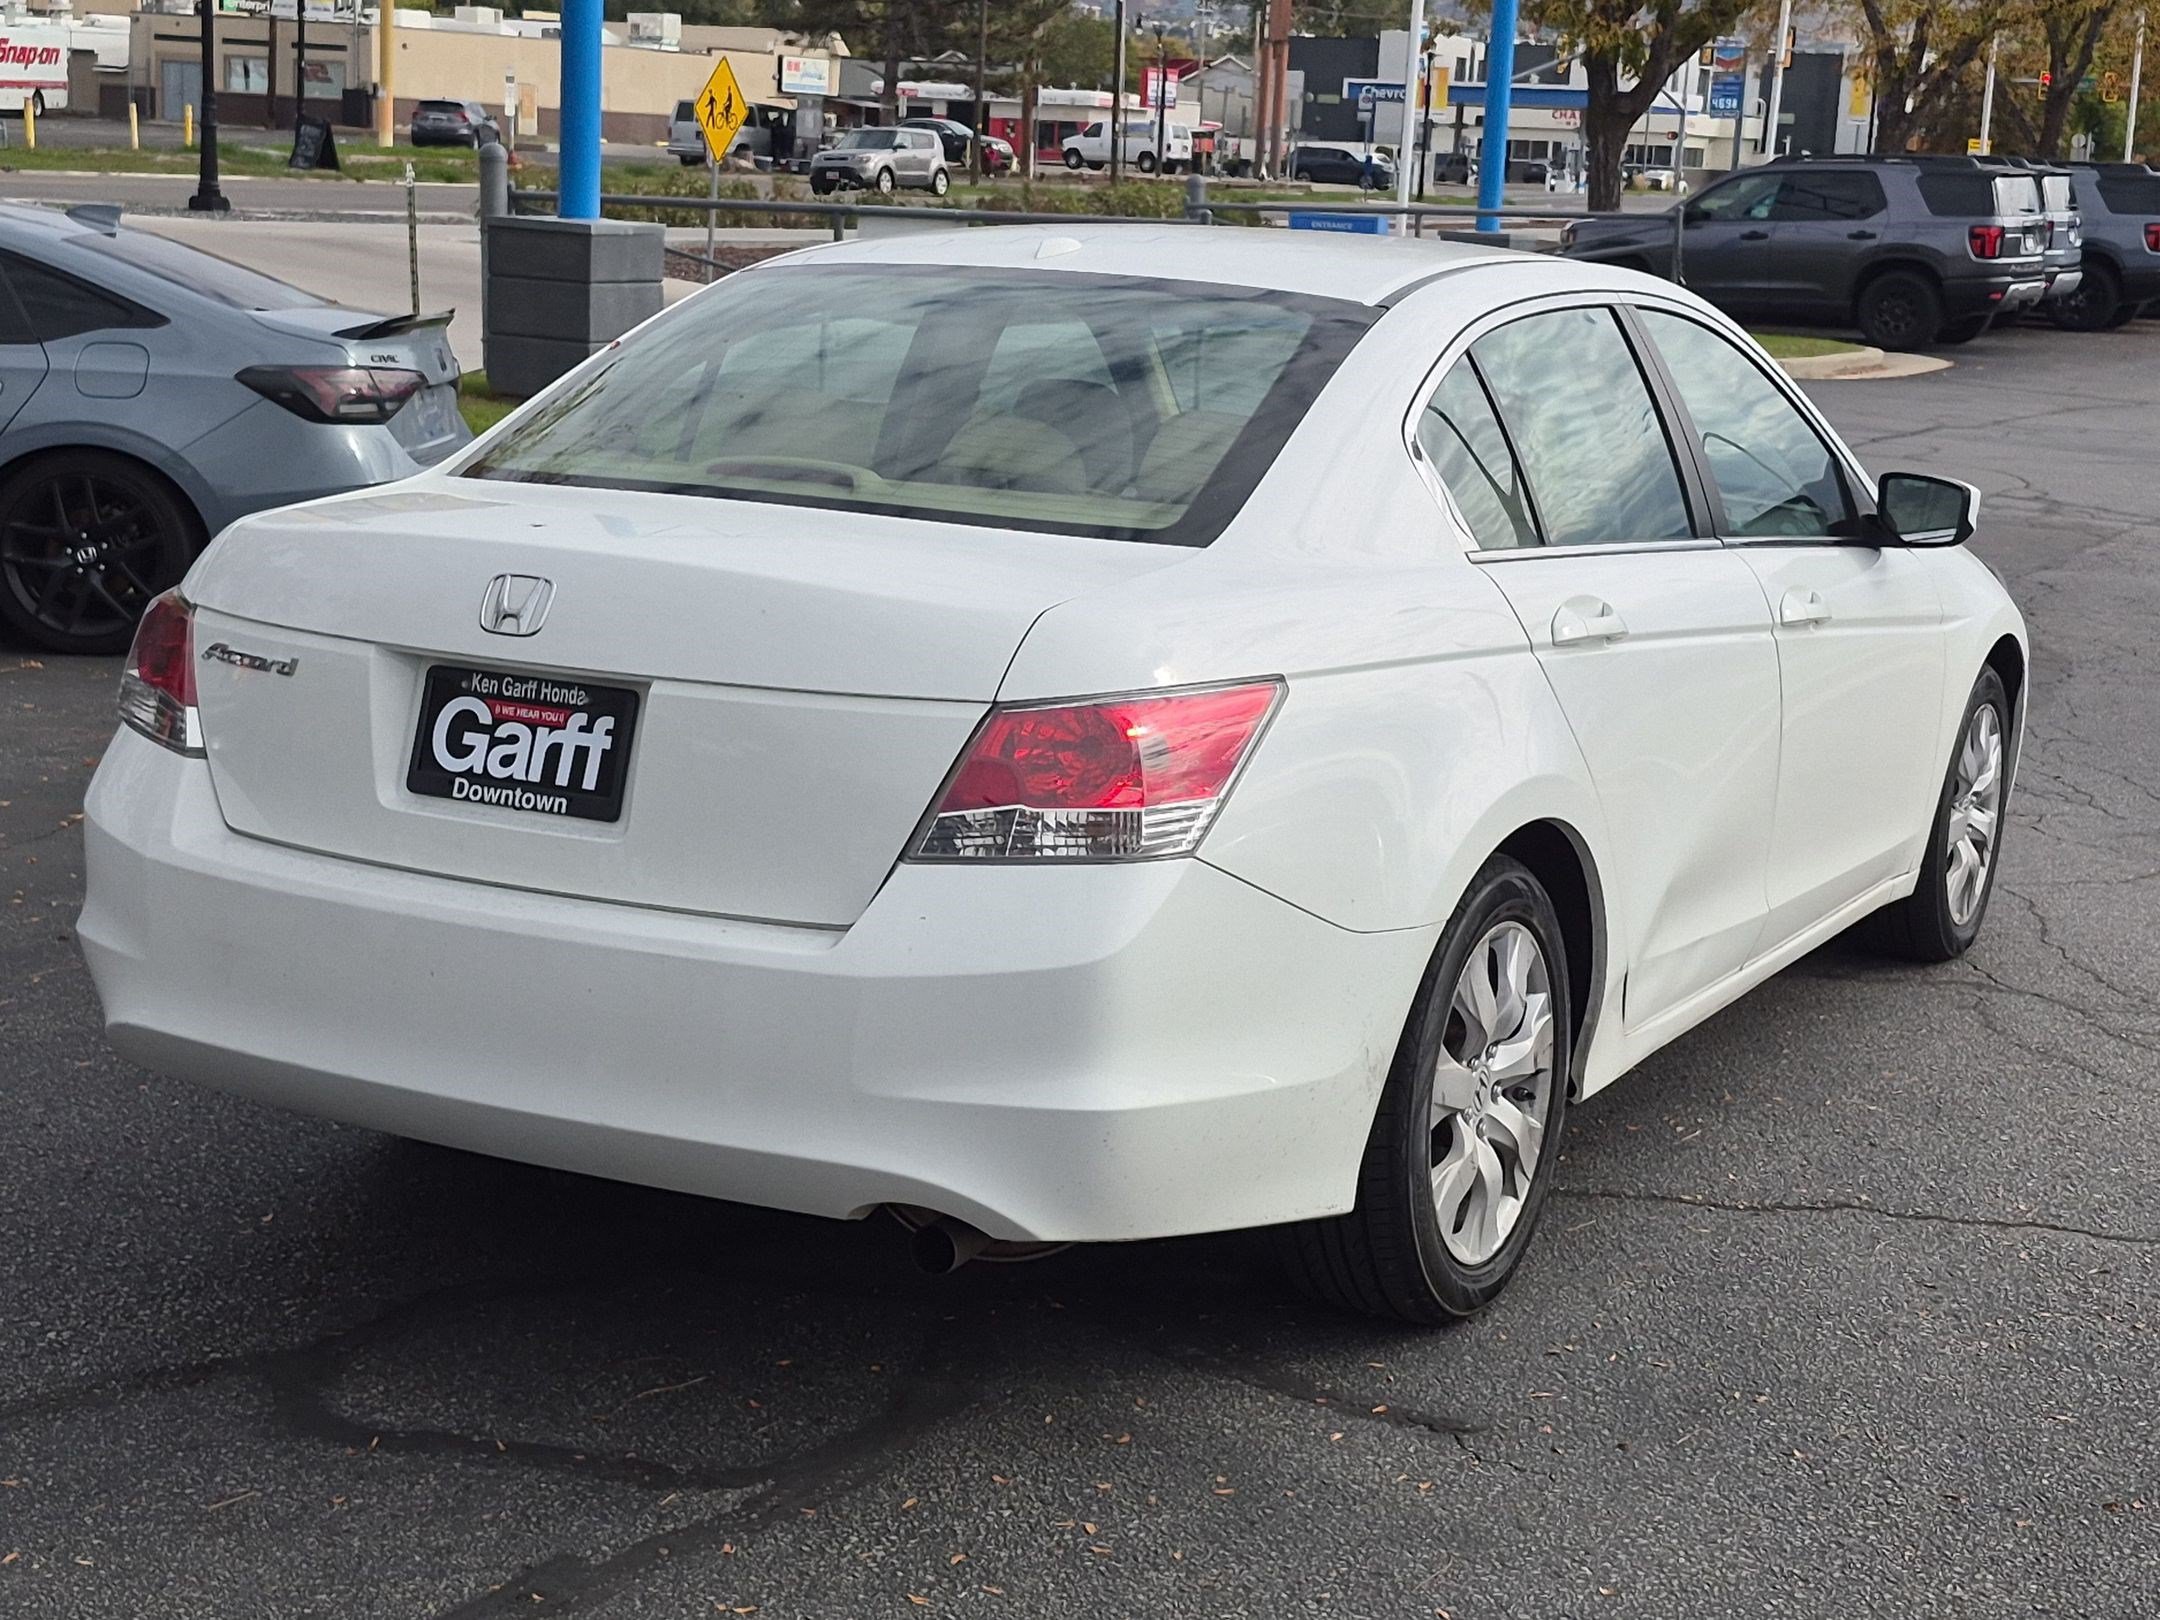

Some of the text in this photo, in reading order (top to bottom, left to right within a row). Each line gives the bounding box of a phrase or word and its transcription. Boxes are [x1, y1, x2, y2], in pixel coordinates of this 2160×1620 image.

[0, 38, 60, 71] Snap-on
[1311, 221, 1353, 230] ENTRANCE
[371, 354, 400, 363] CIVIC
[201, 642, 299, 677] Accord
[471, 672, 586, 705] Ken Garff Honda
[502, 705, 559, 721] WE HEAR YOU
[432, 696, 615, 791] Garff
[452, 777, 568, 814] Downtown
